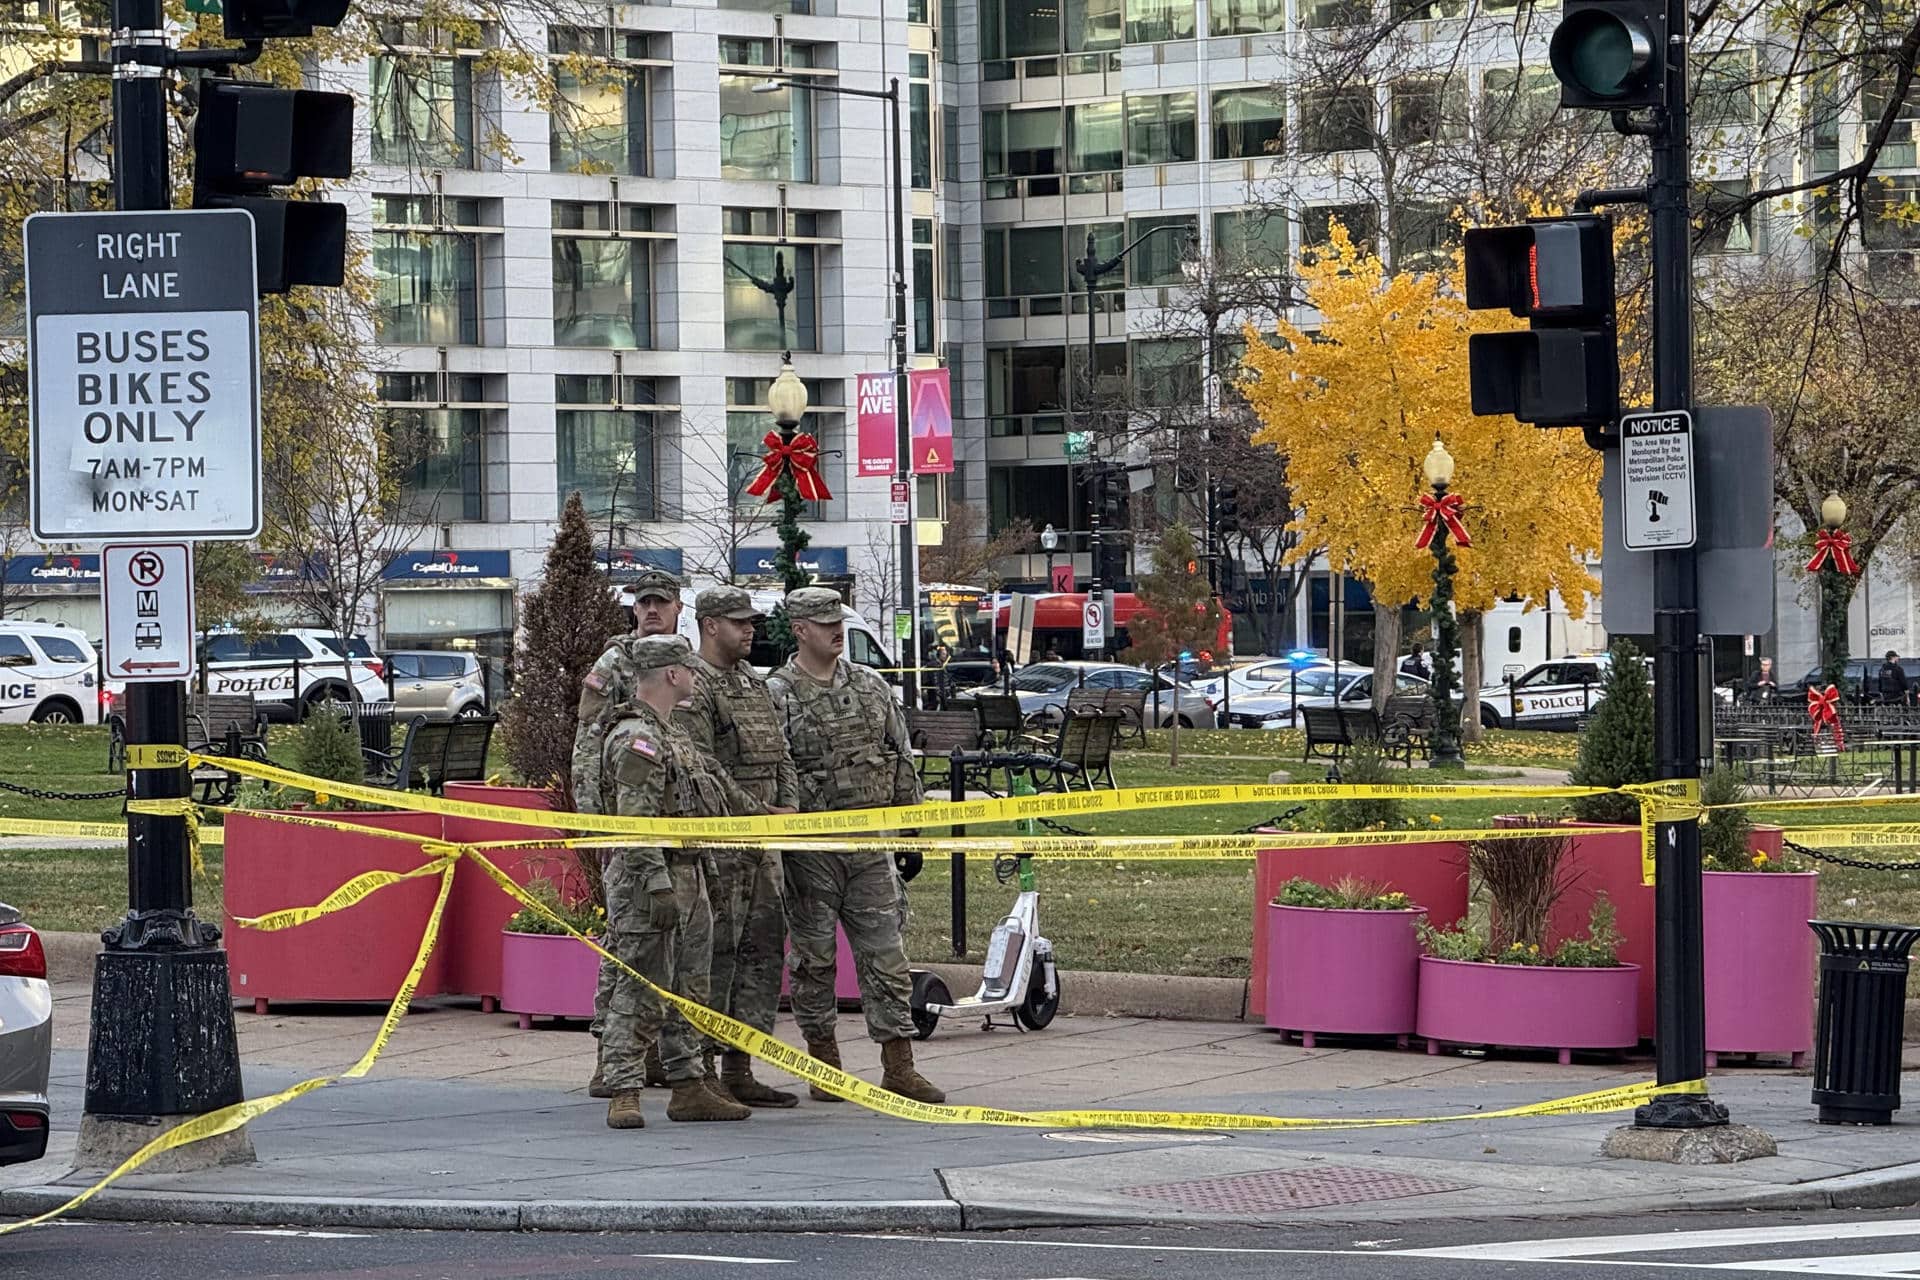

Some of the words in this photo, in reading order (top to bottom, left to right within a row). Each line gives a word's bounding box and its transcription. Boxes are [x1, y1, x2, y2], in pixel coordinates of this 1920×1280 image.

[97, 232, 181, 259] RIGHT
[103, 272, 180, 299] LANE
[76, 329, 210, 364] BUSES
[77, 371, 211, 406] BIKES
[859, 378, 893, 397] ART
[859, 396, 893, 415] AVE
[83, 410, 205, 444] ONLY
[1631, 417, 1680, 434] NOTICE
[1632, 439, 1643, 447] This
[1645, 439, 1657, 447] Area
[1659, 437, 1671, 446] May
[1673, 436, 1681, 445] Be
[1629, 456, 1665, 465] Metropolitan
[1666, 454, 1684, 462] Police
[1631, 448, 1660, 456] Monitored
[1662, 447, 1669, 455] by
[87, 457, 206, 480] 7AM-7PM
[1627, 466, 1643, 475] Using
[1645, 464, 1665, 473] Closed
[1667, 463, 1686, 471] Circuit
[1629, 474, 1660, 483] Television
[1662, 471, 1686, 481] (CCTV)
[92, 490, 200, 513] MON-SAT
[138, 591, 157, 610] M
[1870, 625, 1906, 637] citibank
[217, 675, 296, 693] POLICE
[1530, 695, 1585, 710] POLICE
[1666, 783, 1687, 798] CROSS
[722, 1020, 743, 1040] POLICE
[760, 1039, 784, 1061] CROSS
[784, 1050, 797, 1068] NOT
[798, 1056, 808, 1071] DO
[808, 1061, 823, 1080] LINE
[823, 1066, 846, 1087] POLICE
[867, 1088, 890, 1102] CROSS
[892, 1095, 905, 1106] NOT
[1599, 1098, 1623, 1109] POLICE
[906, 1100, 916, 1109] DO
[917, 1104, 933, 1114] LINE
[934, 1107, 957, 1118] POLICE
[981, 1111, 1004, 1121] CROSS
